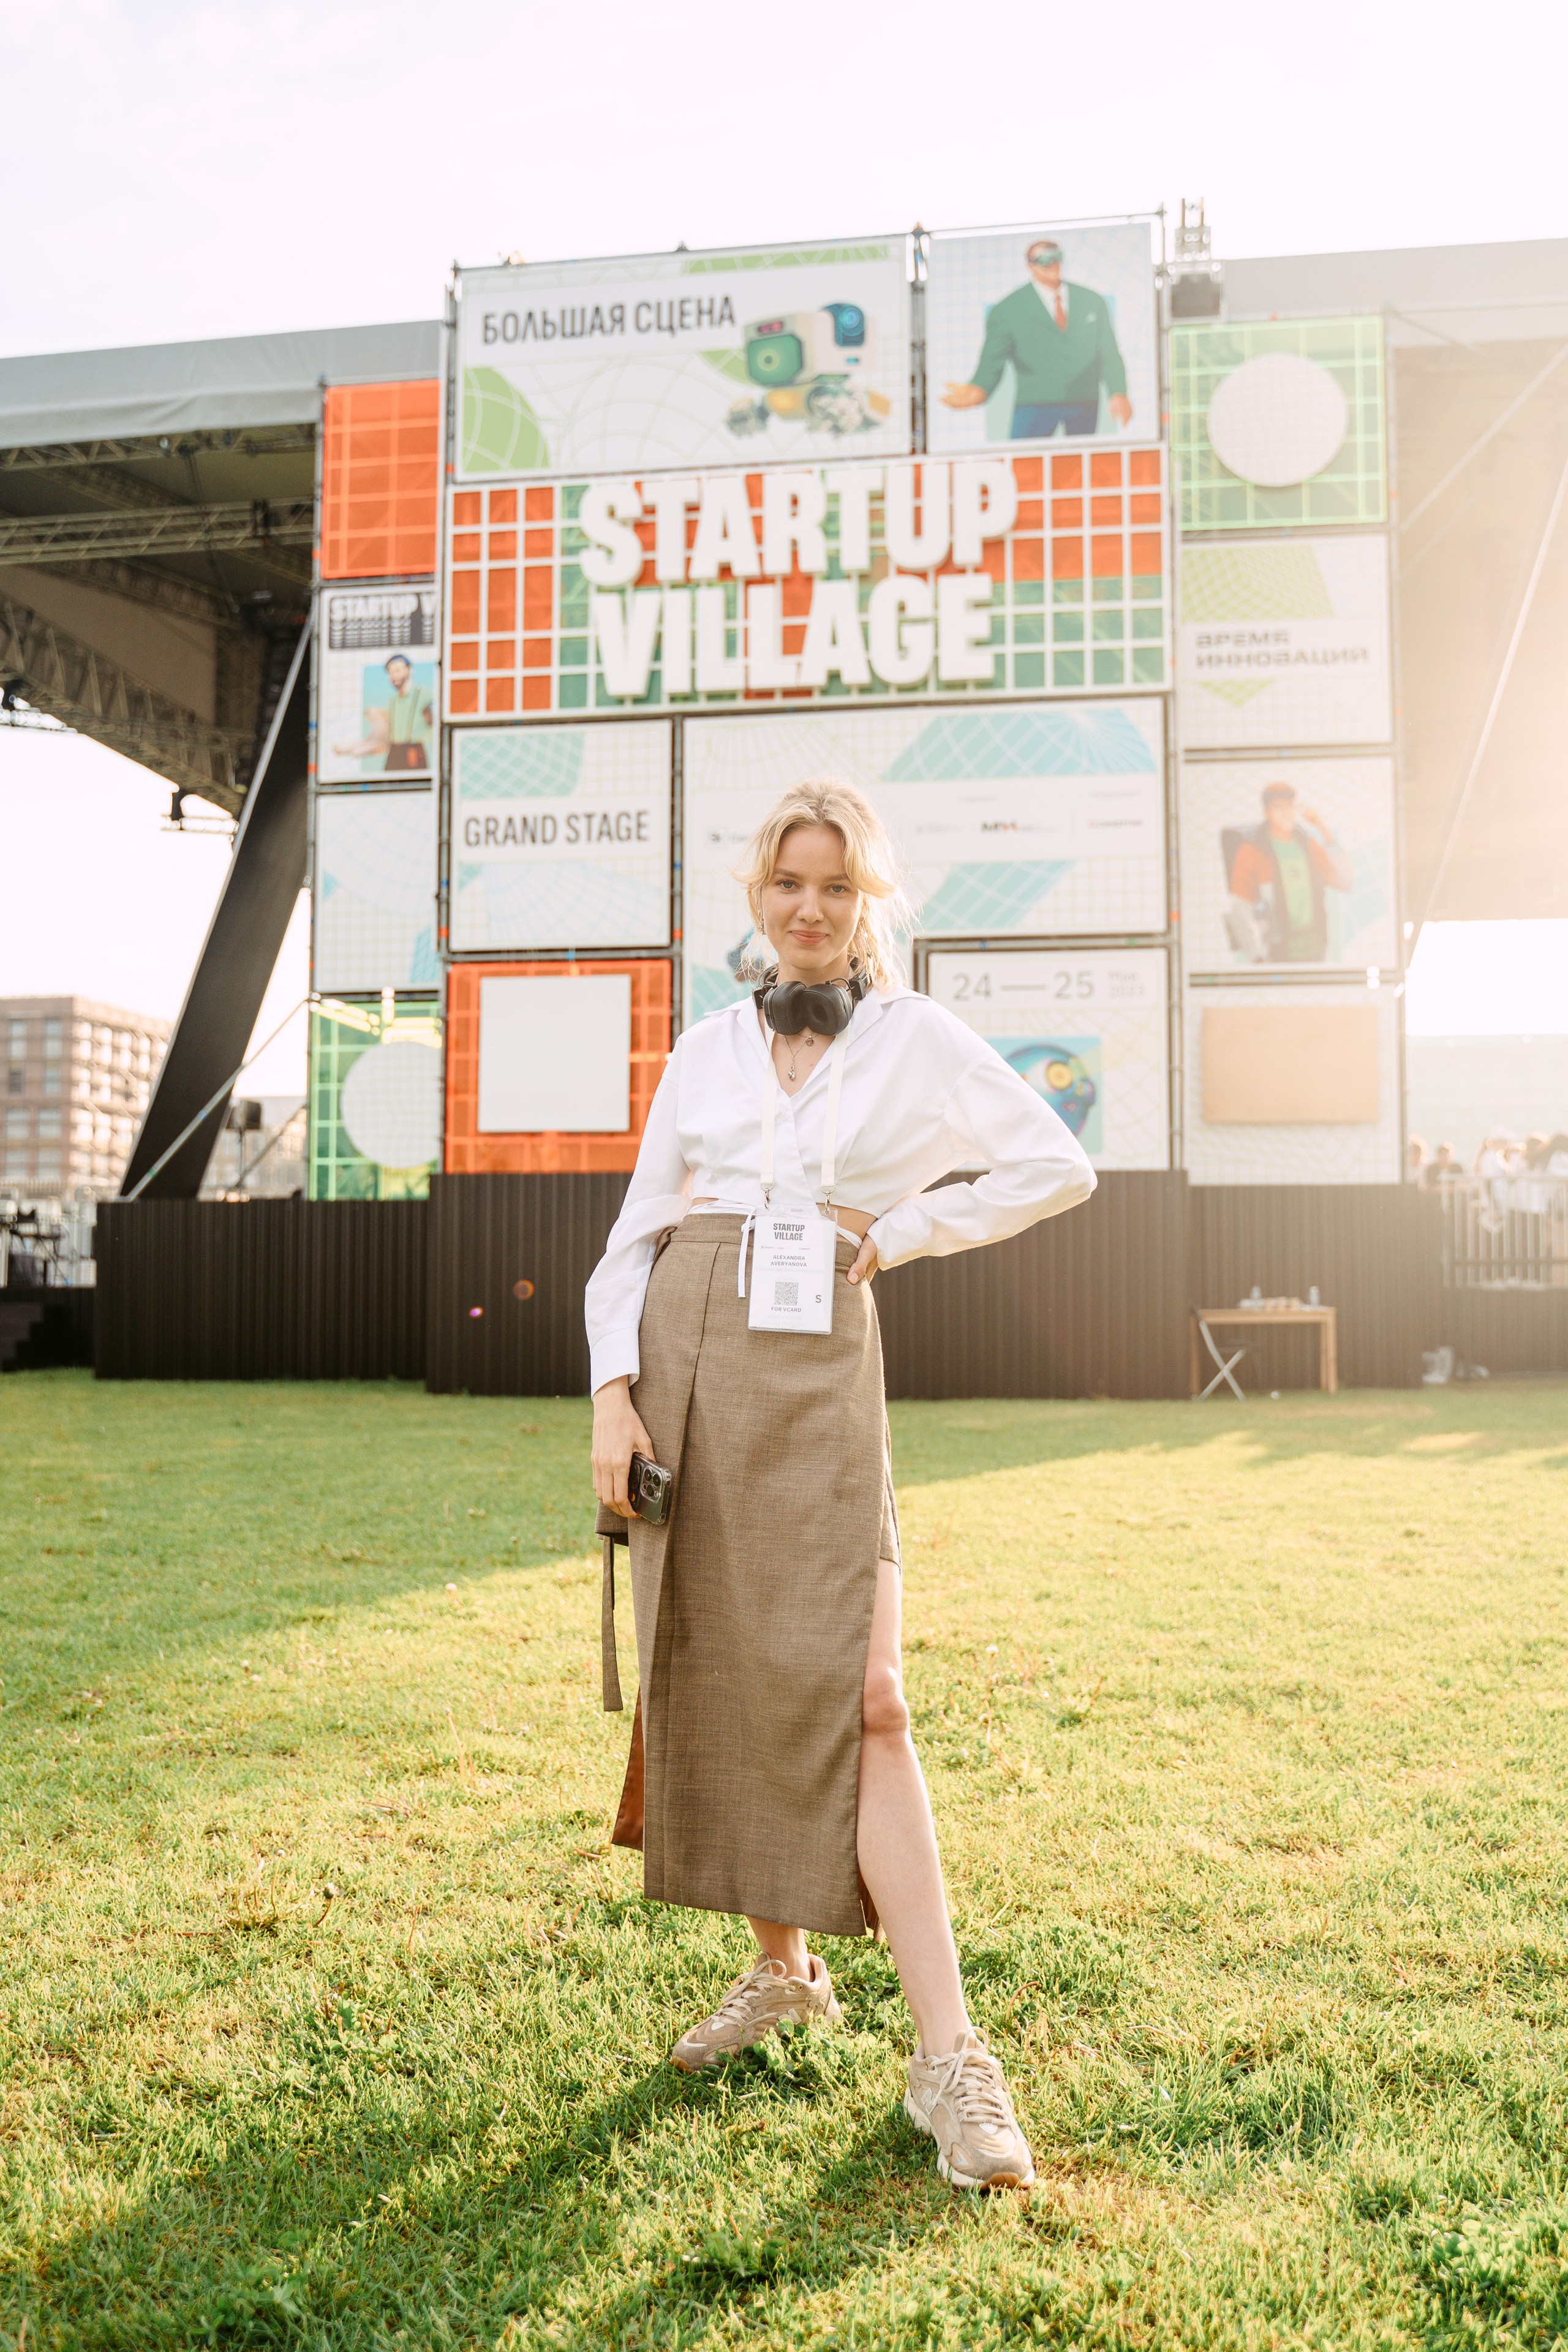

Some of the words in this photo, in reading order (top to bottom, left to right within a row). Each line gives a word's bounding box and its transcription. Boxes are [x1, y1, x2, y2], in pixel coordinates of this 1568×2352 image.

[482, 303, 624, 345] БОЛЬШАЯ
[635, 296, 736, 338] СЦЕНА
[578, 462, 1019, 587] STARTUP
[330, 593, 419, 622] STARTUP
[593, 573, 996, 699] VILLAGE
[1196, 629, 1290, 647] ВРЕМЯ
[464, 814, 557, 846] GRAND
[566, 810, 650, 844] STAGE
[952, 972, 993, 1001] 24
[1054, 970, 1096, 1000] 25
[773, 1223, 805, 1232] STARTUP
[774, 1231, 804, 1241] VILLAGE
[815, 1294, 822, 1303] S
